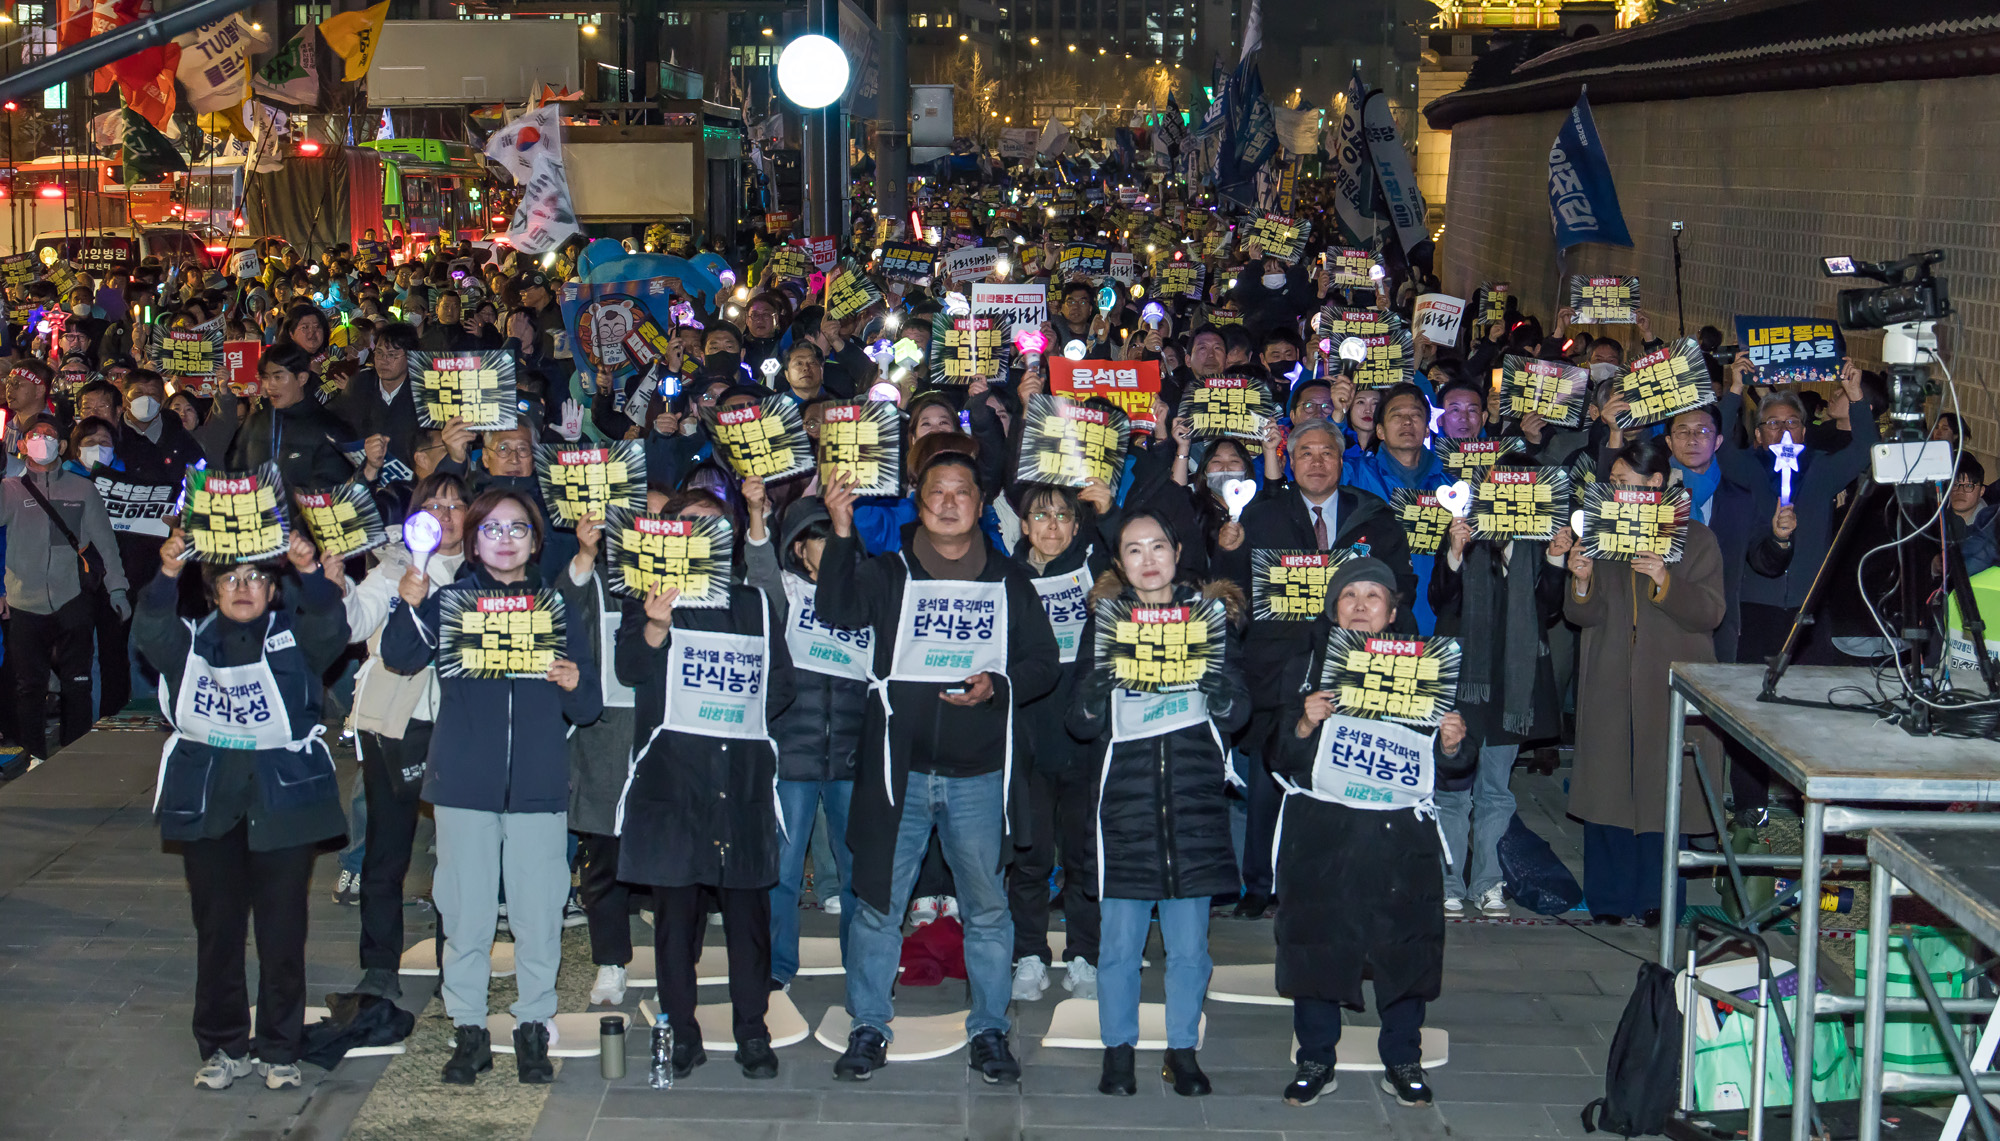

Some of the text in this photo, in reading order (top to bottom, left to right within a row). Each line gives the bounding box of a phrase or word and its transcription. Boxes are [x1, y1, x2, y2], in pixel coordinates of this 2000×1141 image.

[1549, 136, 1599, 232] 양주(갑)
[1254, 218, 1301, 239] 윤석열을
[883, 256, 930, 273] 민주 수호
[887, 248, 935, 263] 내란 종식
[1059, 257, 1104, 269] 민주 수호
[1060, 248, 1106, 261] 내란 종식
[976, 293, 1013, 303] 내란동조
[1582, 286, 1631, 298] 윤석열을
[1582, 306, 1631, 319] 파면하라
[1332, 320, 1389, 334] 윤석열을
[1748, 324, 1834, 345] 내란 종식
[163, 338, 213, 352] 윤석열을
[945, 330, 1002, 347] 윤석열을
[1748, 339, 1836, 366] 민주 수호
[163, 358, 213, 372] 파면하라
[944, 359, 999, 377] 파면하라
[1623, 355, 1690, 392] 윤석열을
[424, 369, 498, 390] 윤석열을
[1071, 368, 1138, 389] 윤석열
[1353, 369, 1403, 384] 면하라
[1514, 371, 1573, 395] 윤석열을
[1193, 387, 1261, 405] 윤석열을
[1629, 383, 1699, 419] 파면하라
[428, 403, 499, 423] 파면하라
[1511, 396, 1568, 419] 파면하라
[1193, 412, 1257, 432] 파면하라
[1043, 415, 1120, 451] 윤석열을
[562, 450, 602, 464] 내란수괴
[1463, 442, 1494, 452] 내란수괴
[1037, 450, 1114, 485] 파면하라
[1448, 452, 1502, 467] 윤석열
[549, 461, 628, 486] 윤석열을
[95, 476, 172, 501] 윤석열을
[208, 478, 250, 492] 내란수괴
[1478, 483, 1553, 503] 윤석열을
[193, 486, 277, 516] 윤석열을
[1600, 501, 1675, 523] 윤석열을
[639, 519, 684, 534] 내란수괴
[1477, 514, 1553, 533] 파면하라
[193, 523, 283, 554] 파면하라
[622, 528, 711, 558] 윤석열을
[1598, 532, 1672, 555] 파면하라
[1285, 555, 1322, 566] 내란수괴
[483, 597, 528, 611] 내란수괴
[917, 598, 995, 613] 윤석열 즉각파면
[1270, 595, 1325, 614] 파면하
[462, 610, 553, 634] 윤석열을
[1137, 609, 1182, 622] 내란수괴
[914, 613, 994, 640] 단식농성
[1116, 621, 1207, 645] 윤석열을
[1371, 640, 1415, 653] 내란수괴
[462, 649, 555, 671] 파면하라
[683, 647, 762, 668] 윤석열 즉각파면
[925, 654, 974, 668] 비상행동
[1346, 650, 1440, 680] 윤석열을
[682, 663, 761, 694] 단식농성
[1115, 658, 1207, 682] 파면하라
[1339, 686, 1435, 717] 파면하라
[698, 706, 744, 724] 비상행동
[1336, 726, 1420, 762] 윤석열 즉각파면
[1331, 742, 1420, 787] 단식농성
